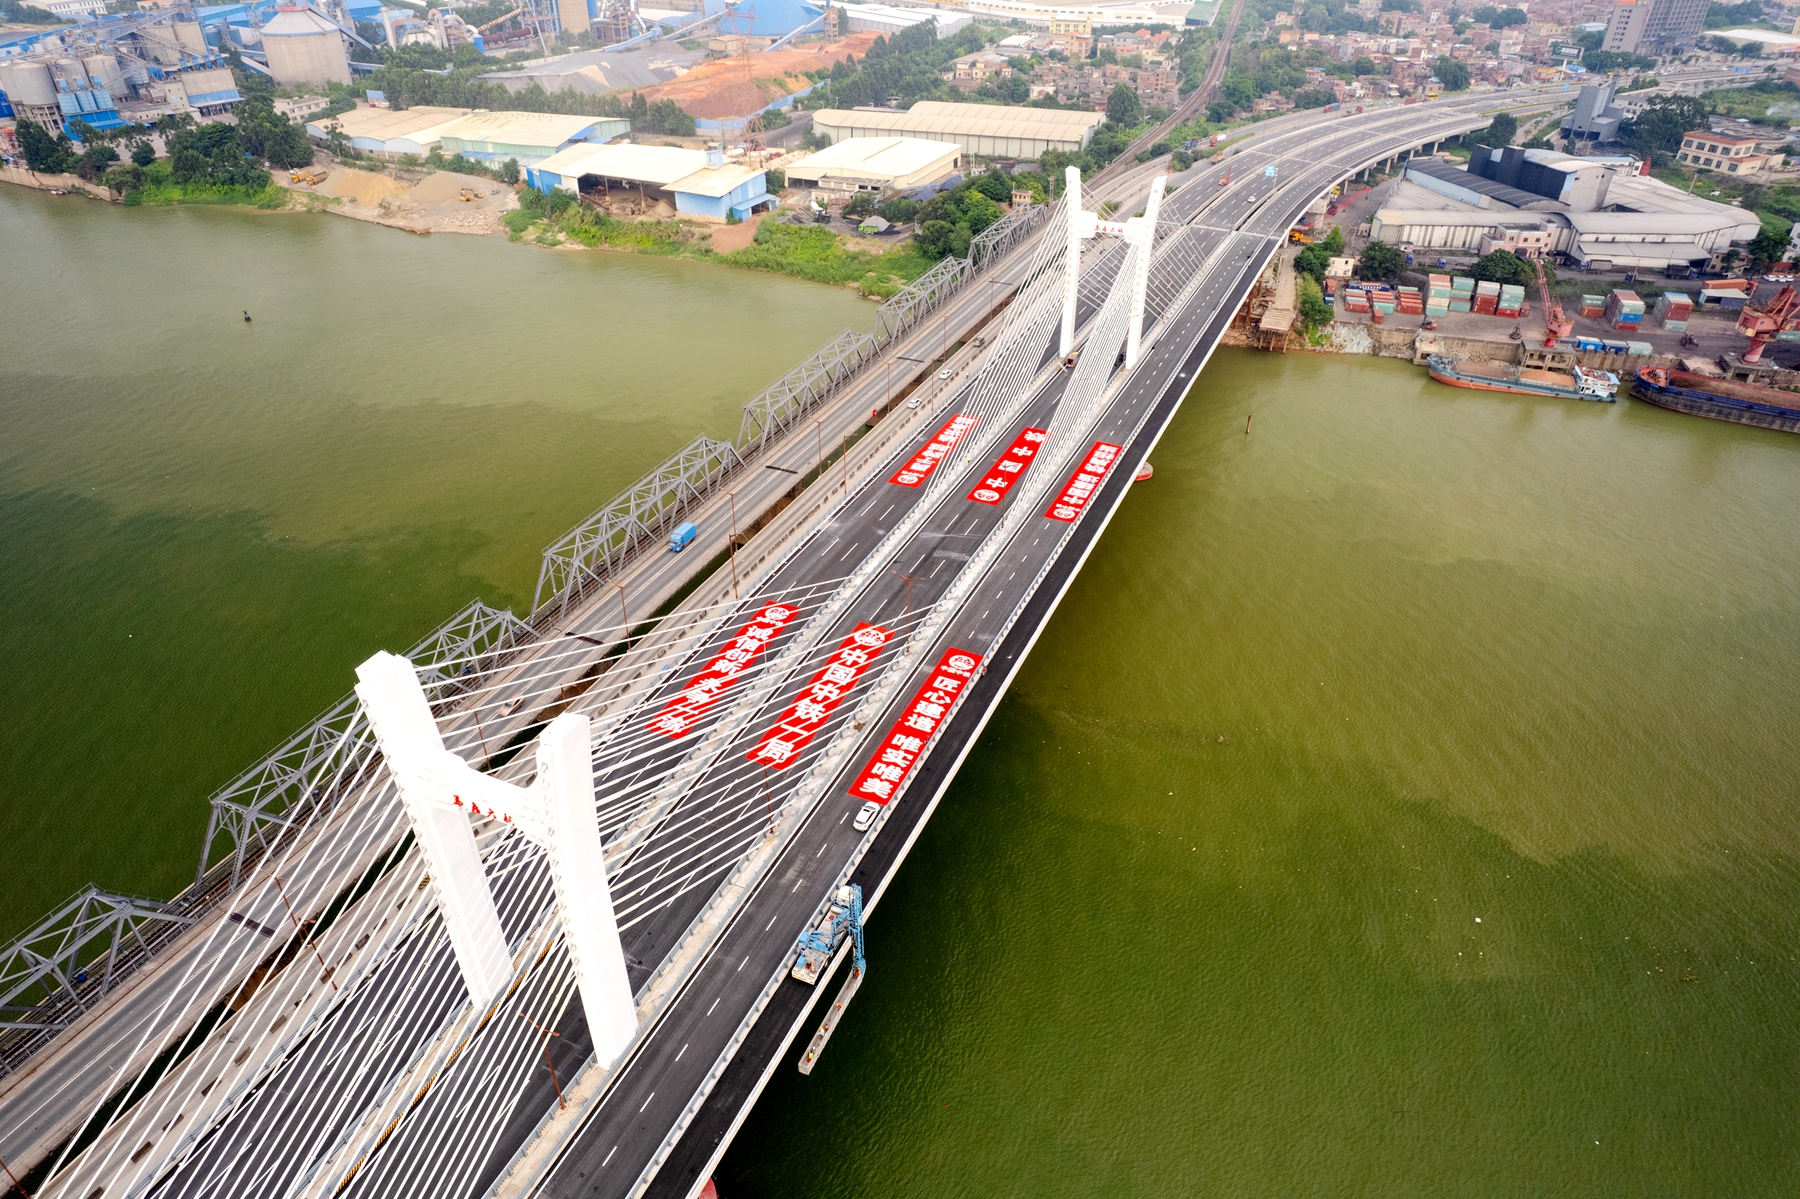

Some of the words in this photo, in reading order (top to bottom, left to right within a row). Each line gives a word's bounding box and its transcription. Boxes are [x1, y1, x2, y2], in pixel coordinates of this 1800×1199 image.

[982, 429, 1047, 490] 中国中铁
[707, 624, 775, 676] 诚信创新
[938, 664, 972, 678] 中国中铁
[653, 674, 727, 734] 永争一流
[755, 645, 874, 764] 中国中铁一局
[902, 674, 964, 733] 匠心建造
[857, 731, 925, 800] 唯实唯美
